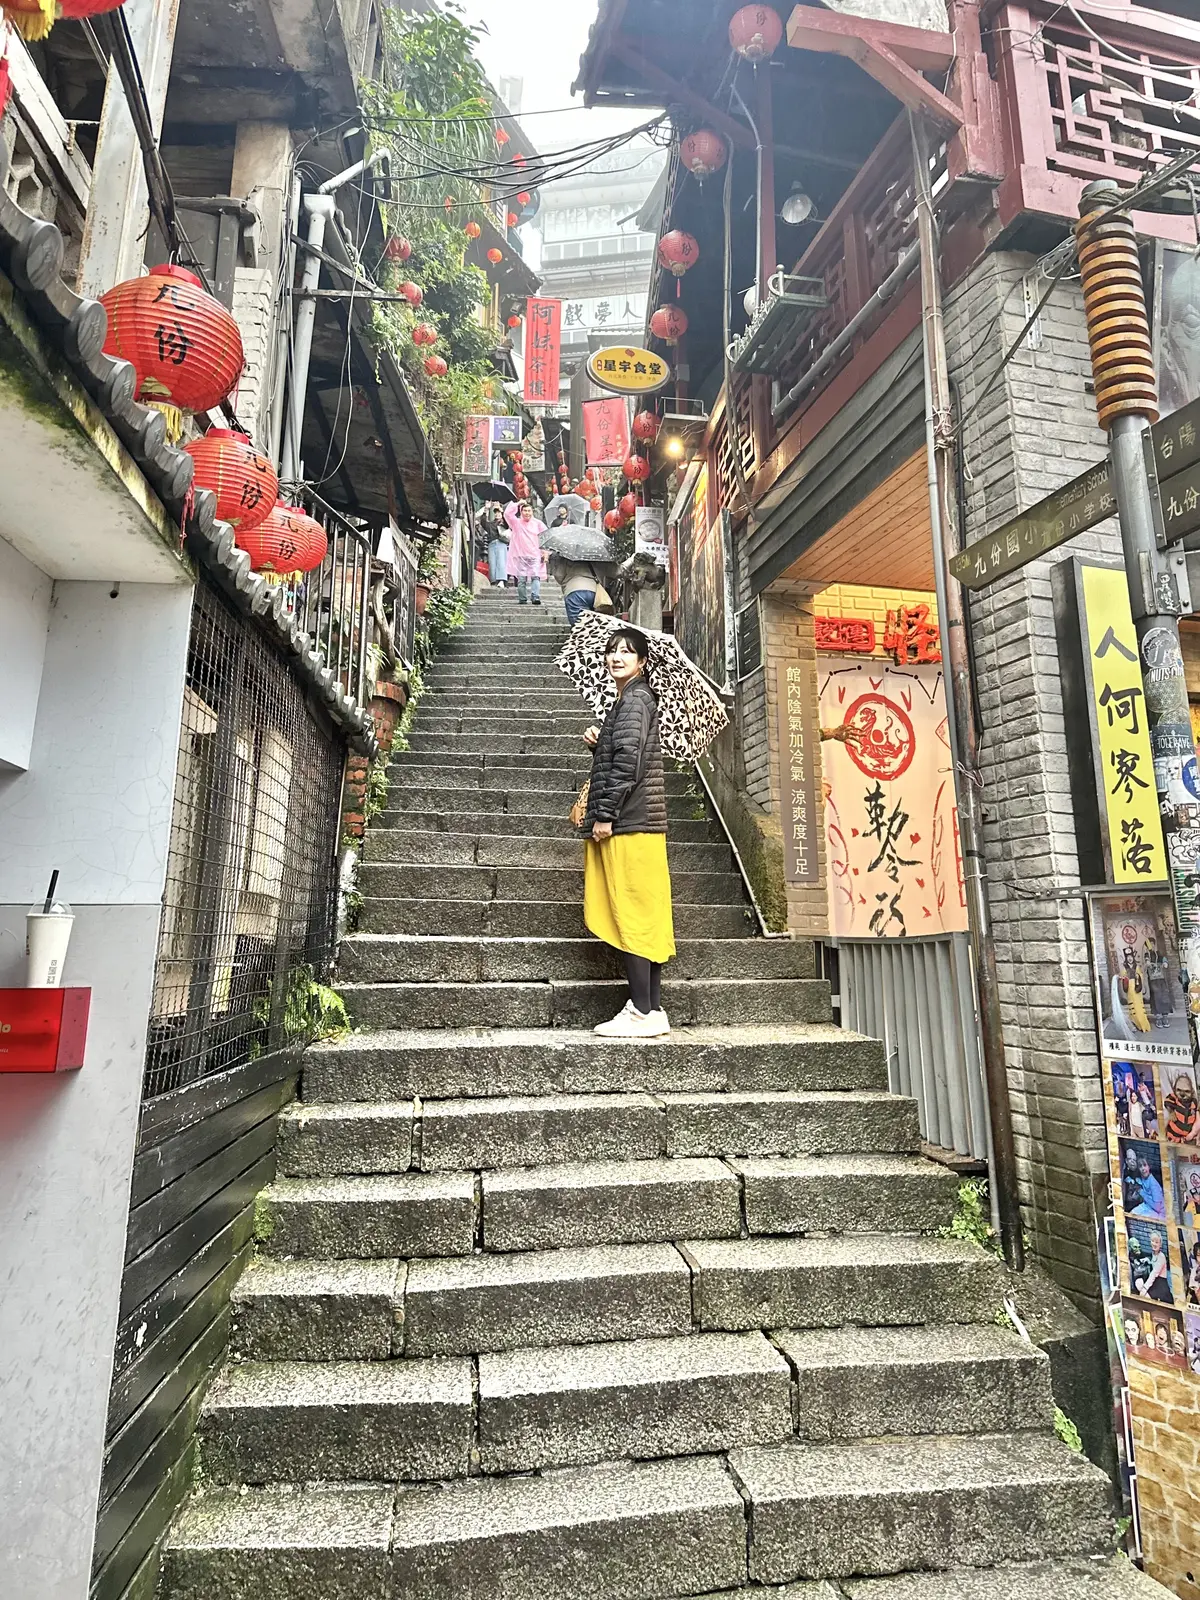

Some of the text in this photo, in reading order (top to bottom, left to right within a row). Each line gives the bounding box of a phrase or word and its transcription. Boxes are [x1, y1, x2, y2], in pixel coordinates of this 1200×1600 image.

[151, 283, 195, 365] 九份
[668, 312, 681, 336] 九份
[529, 302, 556, 397] 阿妹茶樓
[604, 359, 662, 376] 星宇食堂
[1160, 421, 1196, 459] 台陽
[240, 450, 267, 510] 九份
[1086, 464, 1109, 491] School
[1167, 486, 1200, 521] 九份
[279, 515, 300, 561] 九份
[974, 518, 1038, 579] 九份國小
[786, 666, 809, 876] 館內陰氣加冷氣 涼爽度十足
